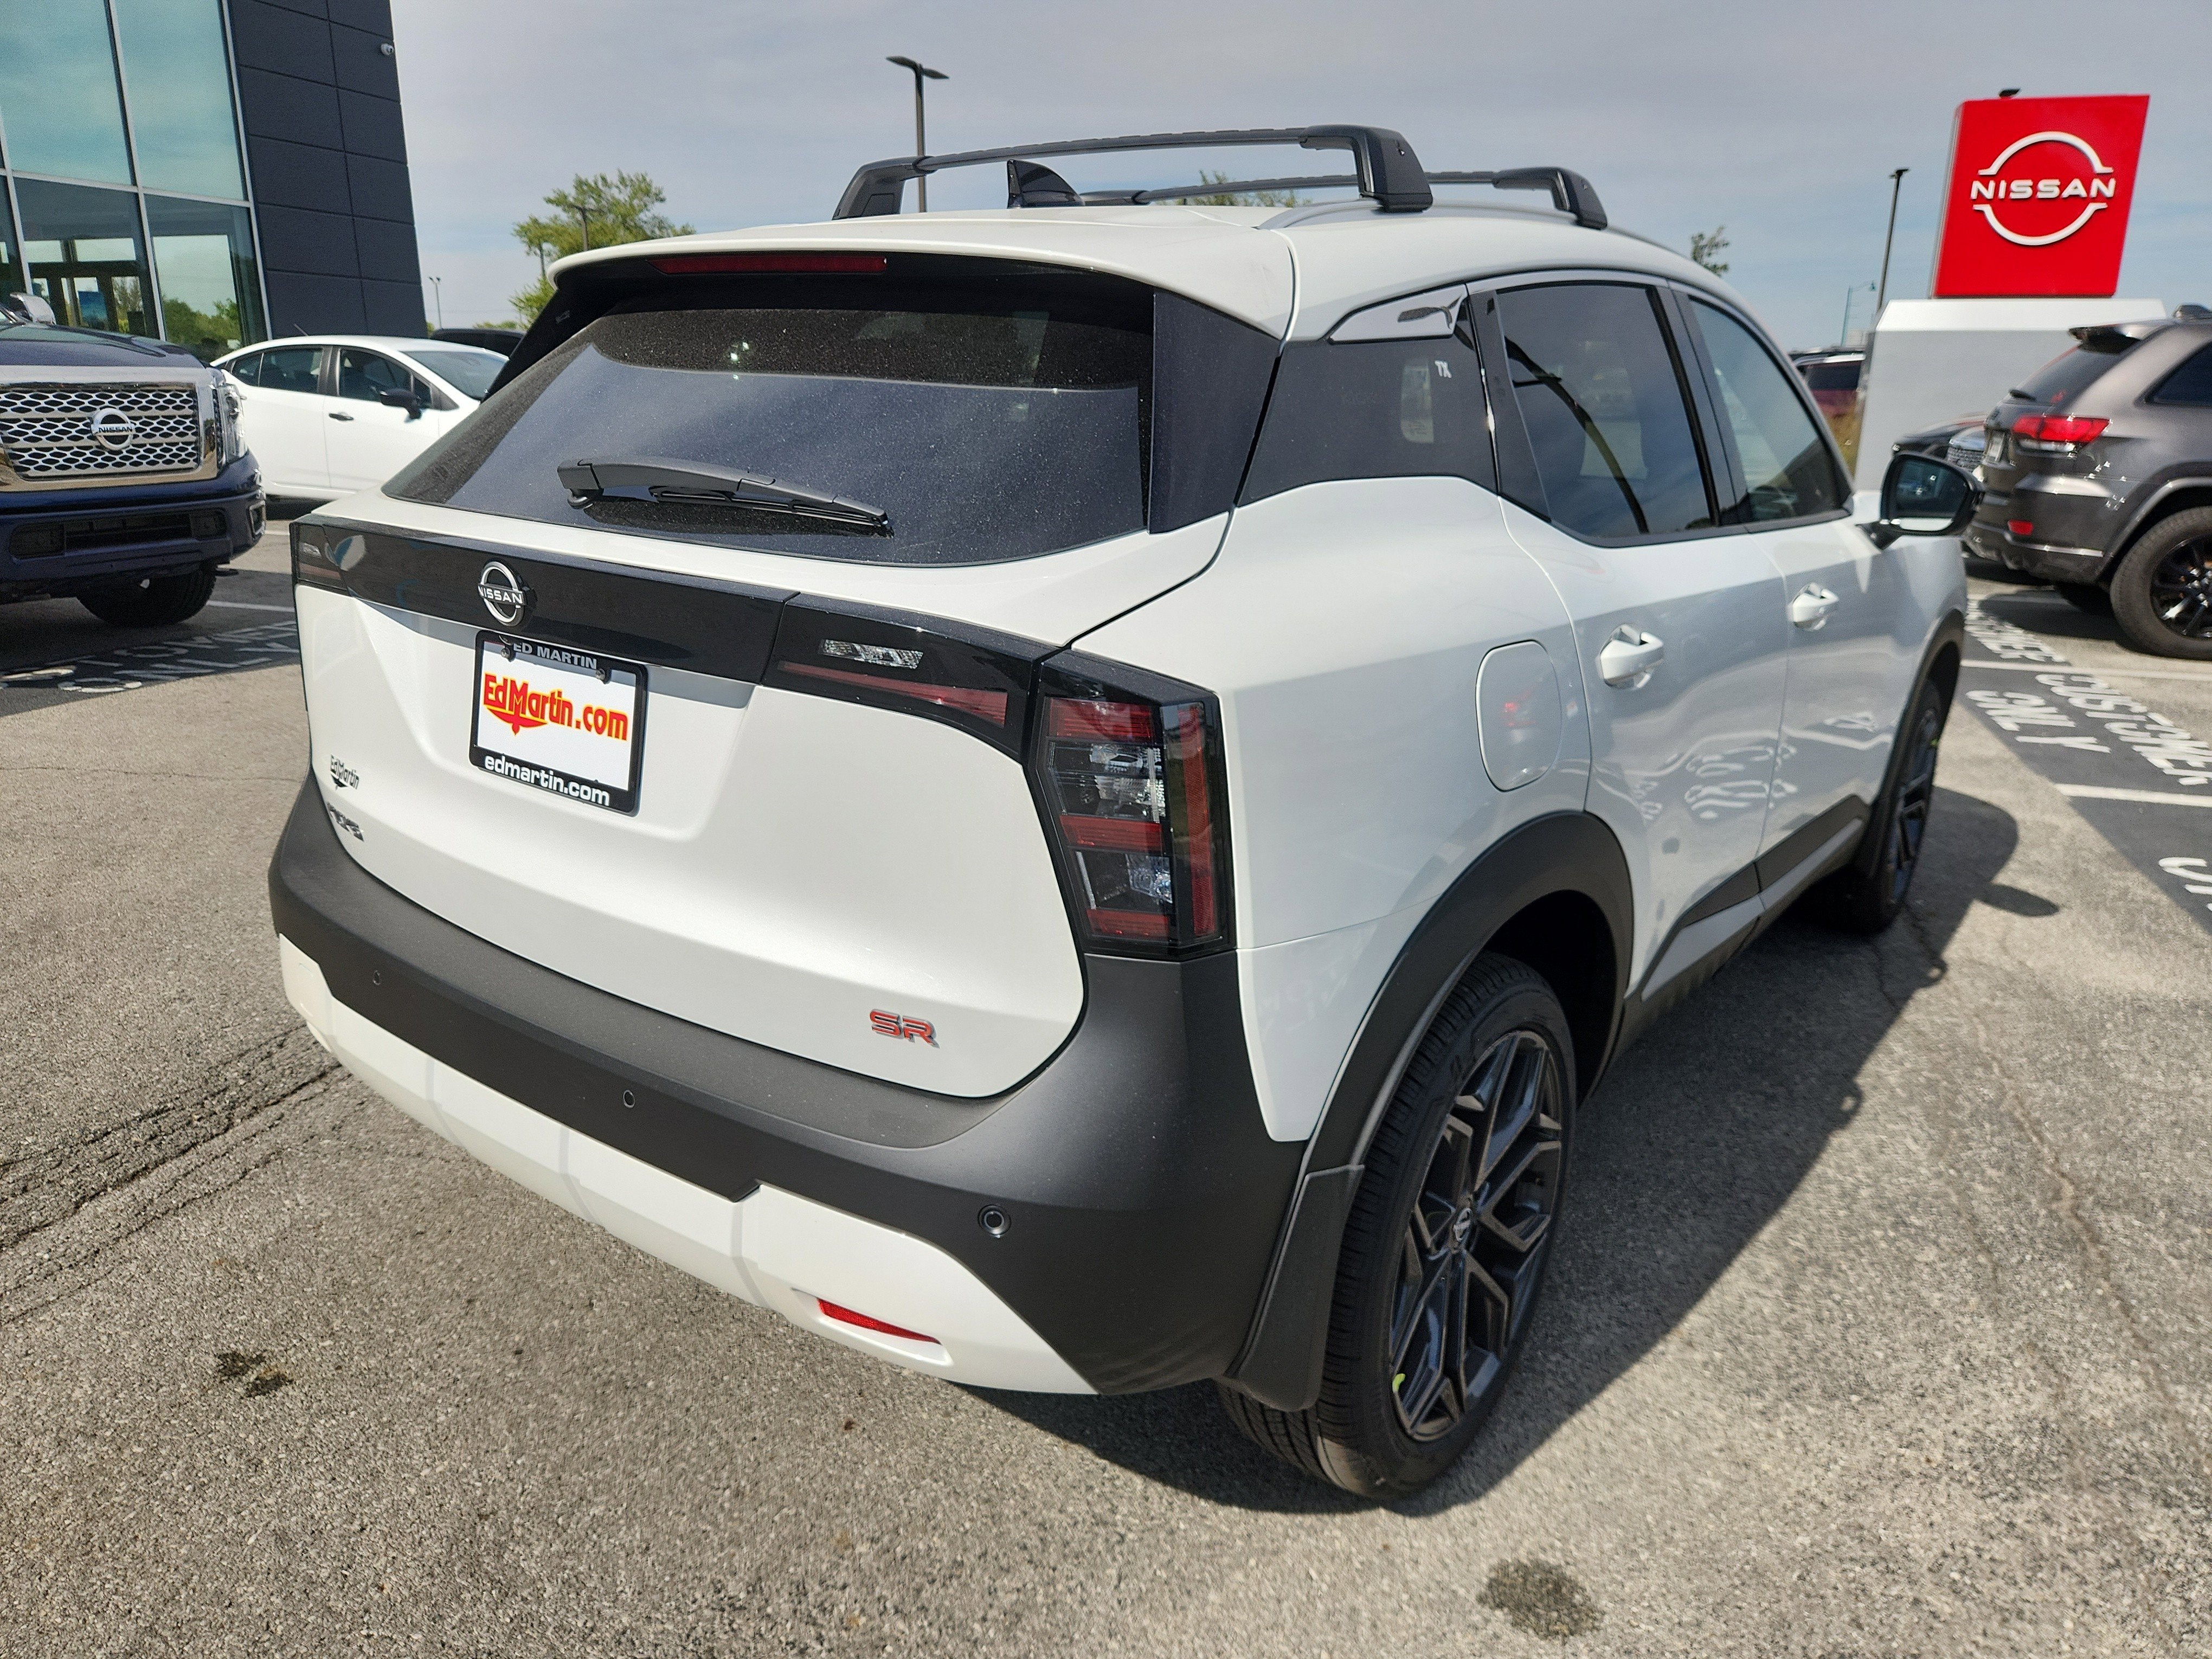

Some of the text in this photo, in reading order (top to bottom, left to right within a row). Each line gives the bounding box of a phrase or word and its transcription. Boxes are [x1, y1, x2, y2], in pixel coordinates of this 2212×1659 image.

[1970, 178, 2117, 200] NISSAN
[478, 586, 523, 604] NISSAN
[513, 642, 597, 670] ED MARTIN
[483, 673, 629, 741] EdMartin.com
[1965, 690, 2113, 754] ONLY
[484, 755, 610, 806] edmartin.com
[870, 1009, 939, 1048] SR
